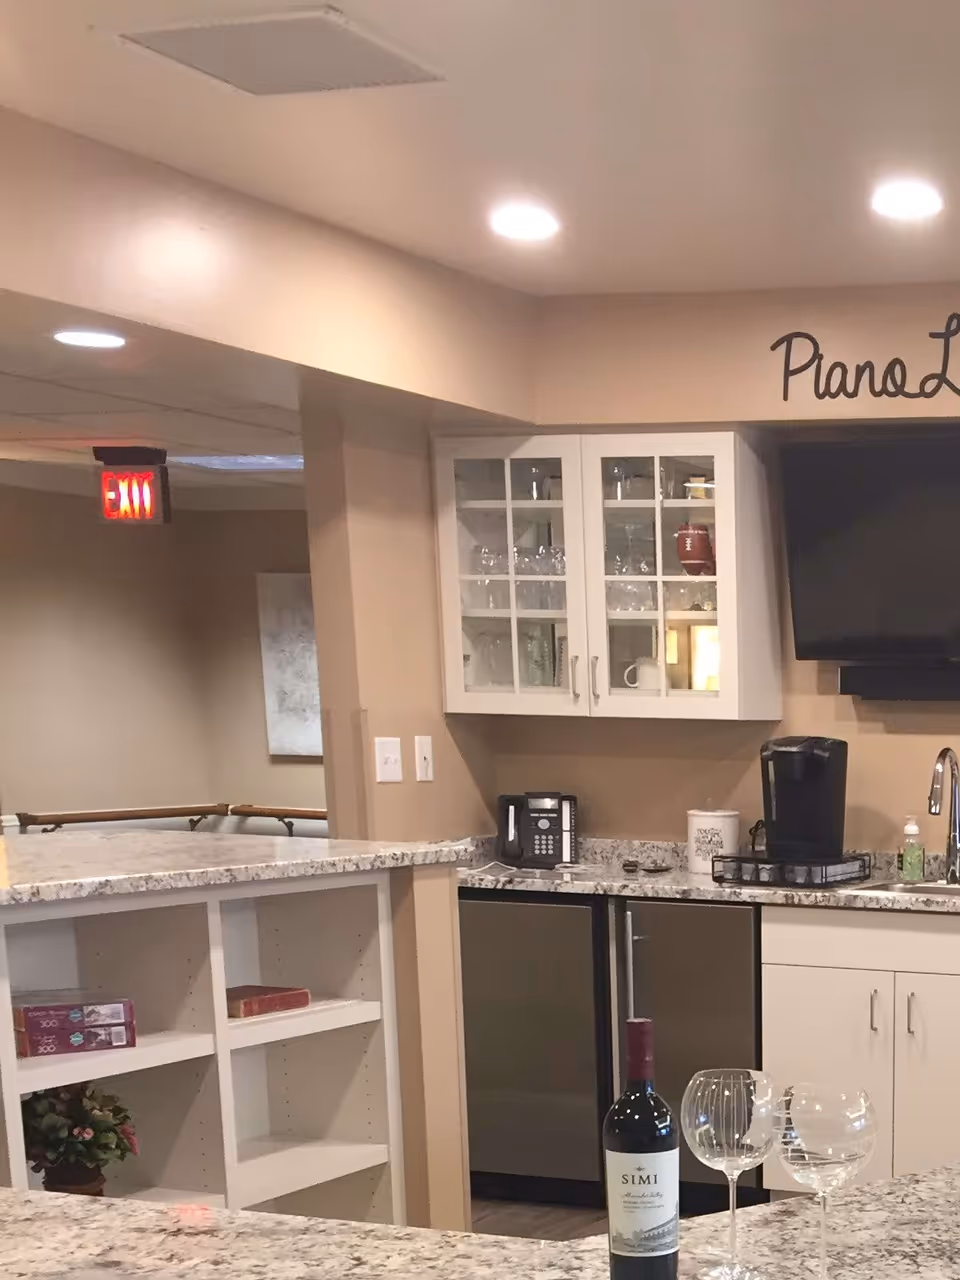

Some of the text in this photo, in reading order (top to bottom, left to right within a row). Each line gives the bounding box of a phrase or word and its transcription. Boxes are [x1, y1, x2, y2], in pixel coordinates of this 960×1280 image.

[770, 331, 912, 401] Piano
[101, 471, 155, 519] EXIT
[622, 1174, 658, 1185] SIMI
